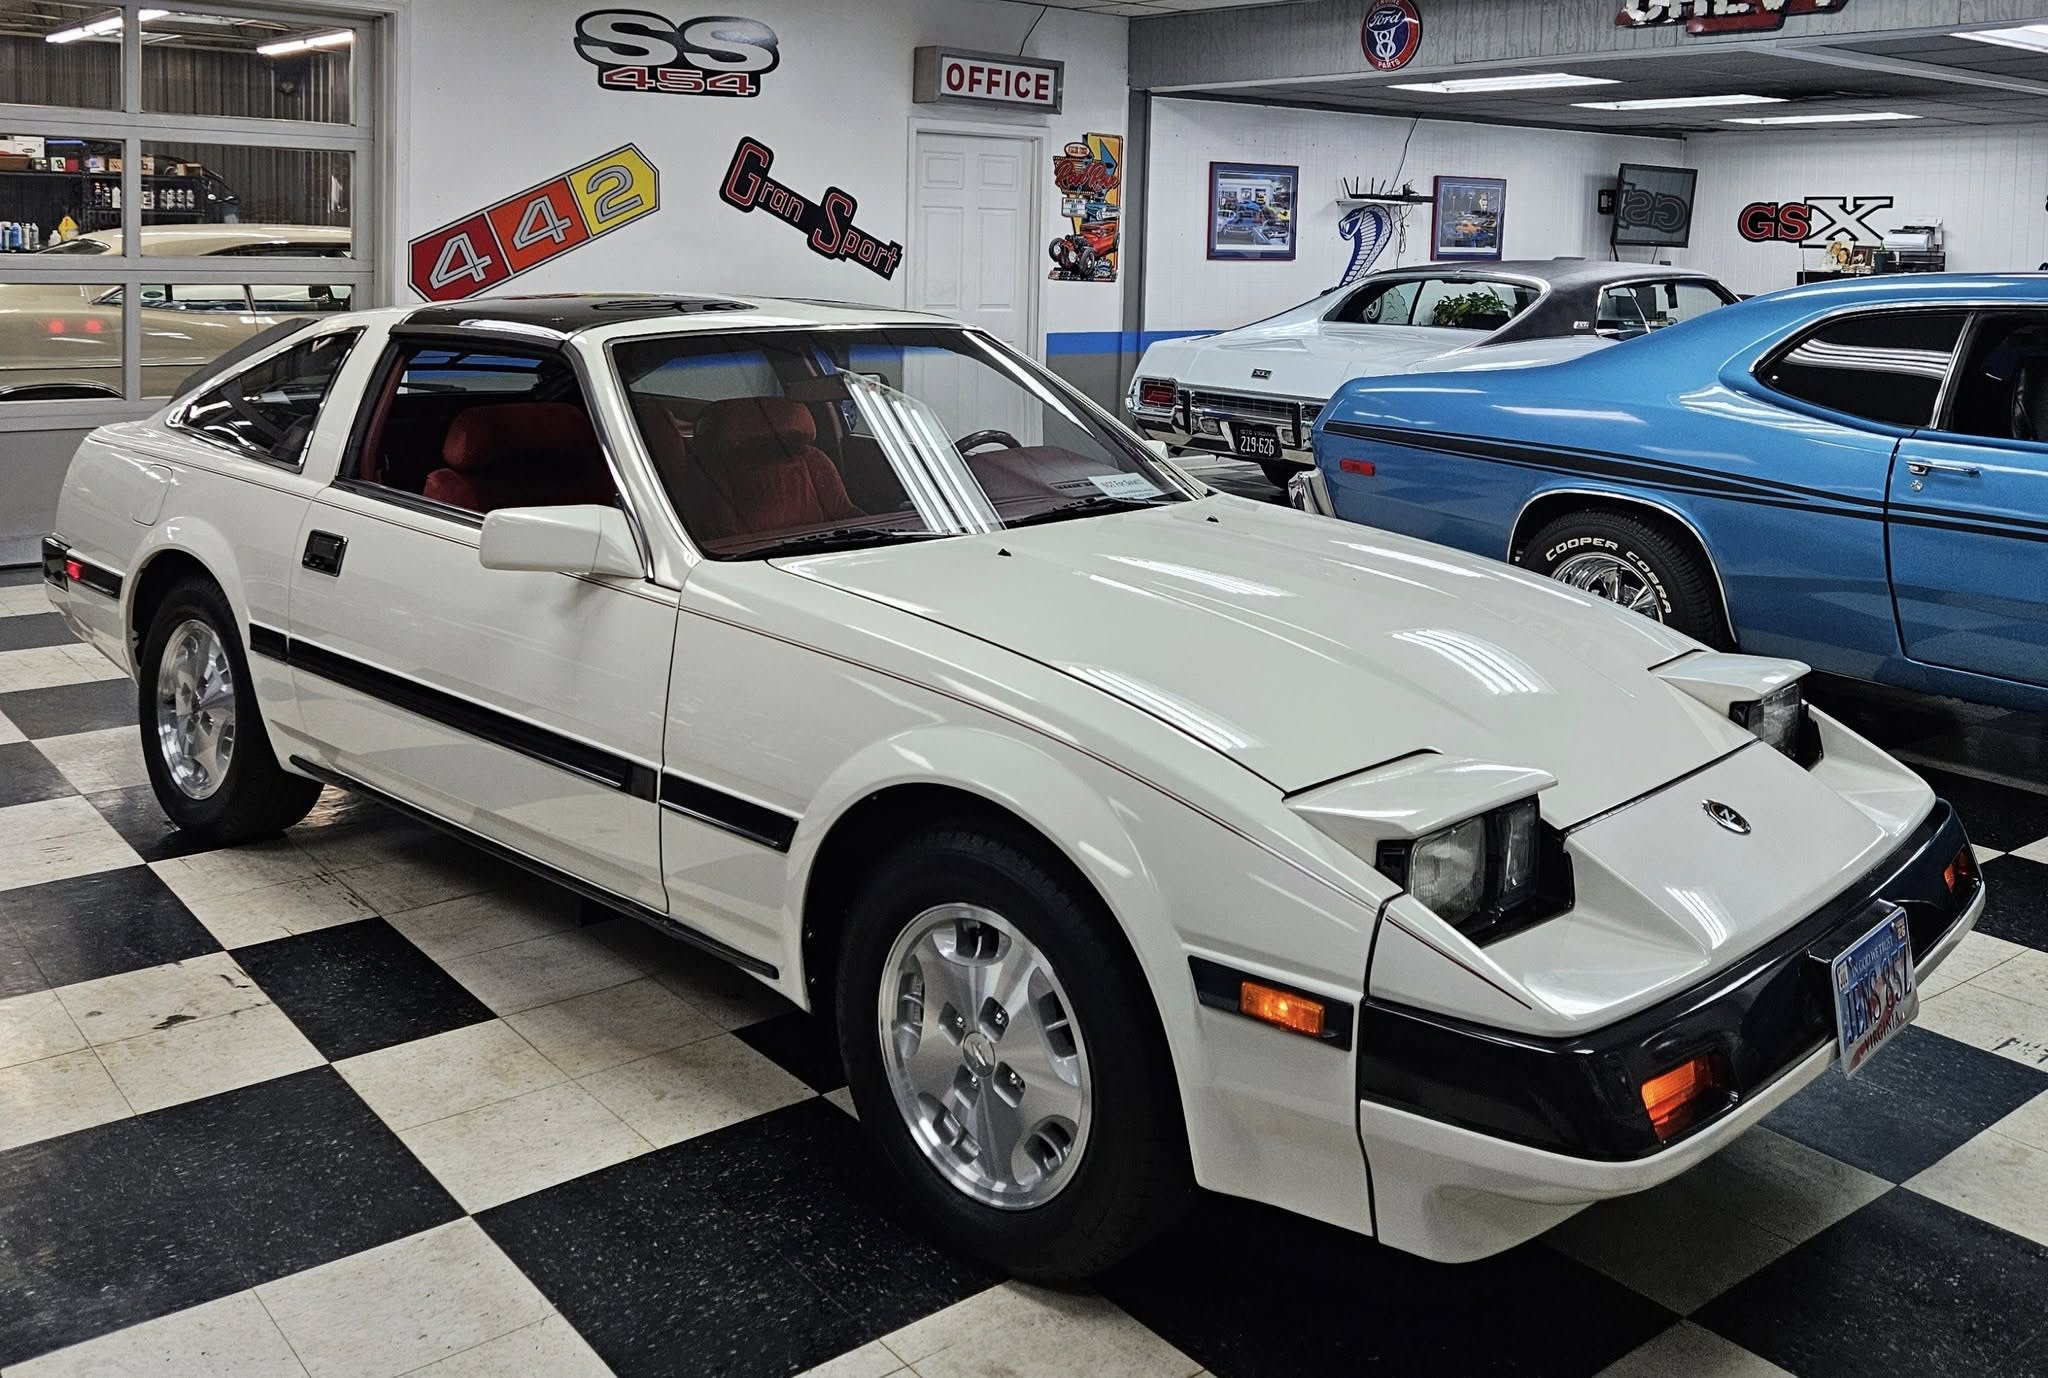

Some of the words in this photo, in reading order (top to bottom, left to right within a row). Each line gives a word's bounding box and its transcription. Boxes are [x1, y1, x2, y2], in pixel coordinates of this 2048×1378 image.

[1369, 10, 1402, 27] Ford
[576, 10, 777, 73] SS
[603, 66, 756, 95] 454
[946, 63, 1050, 100] OFFICE
[1378, 59, 1400, 69] PARTS
[725, 142, 804, 222] Gran
[812, 192, 898, 274] Sport
[1738, 196, 1893, 248] GSX
[1545, 537, 1619, 562] COOPER
[1626, 550, 1672, 614] COBRA
[1864, 1010, 1901, 1052] VIRGINIA
